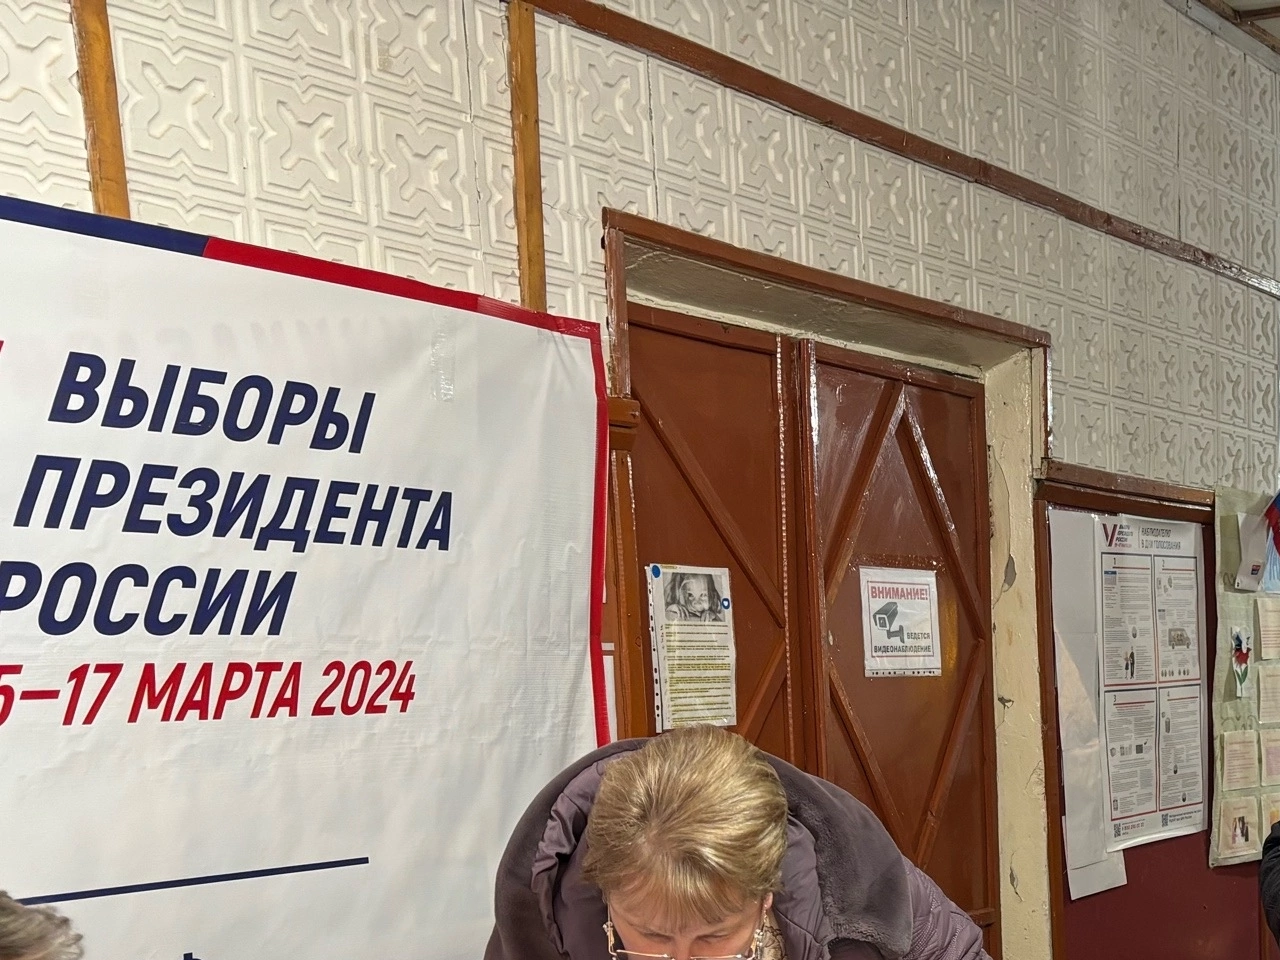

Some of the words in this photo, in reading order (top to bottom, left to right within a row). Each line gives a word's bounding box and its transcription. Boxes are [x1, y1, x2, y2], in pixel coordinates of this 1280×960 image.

[48, 351, 376, 453] ВЫБОРЫ
[13, 454, 453, 553] ПРЕЗИДЕНТА
[0, 560, 298, 636] РОССИИ
[871, 586, 928, 600] ВНИМАНИЕ!
[874, 645, 931, 654] ВИДЕОНАБЛЮДЕНИЕ
[906, 632, 930, 640] ВЕДЕТСЯ
[127, 661, 302, 723] МАРТА
[311, 659, 416, 716] 2024
